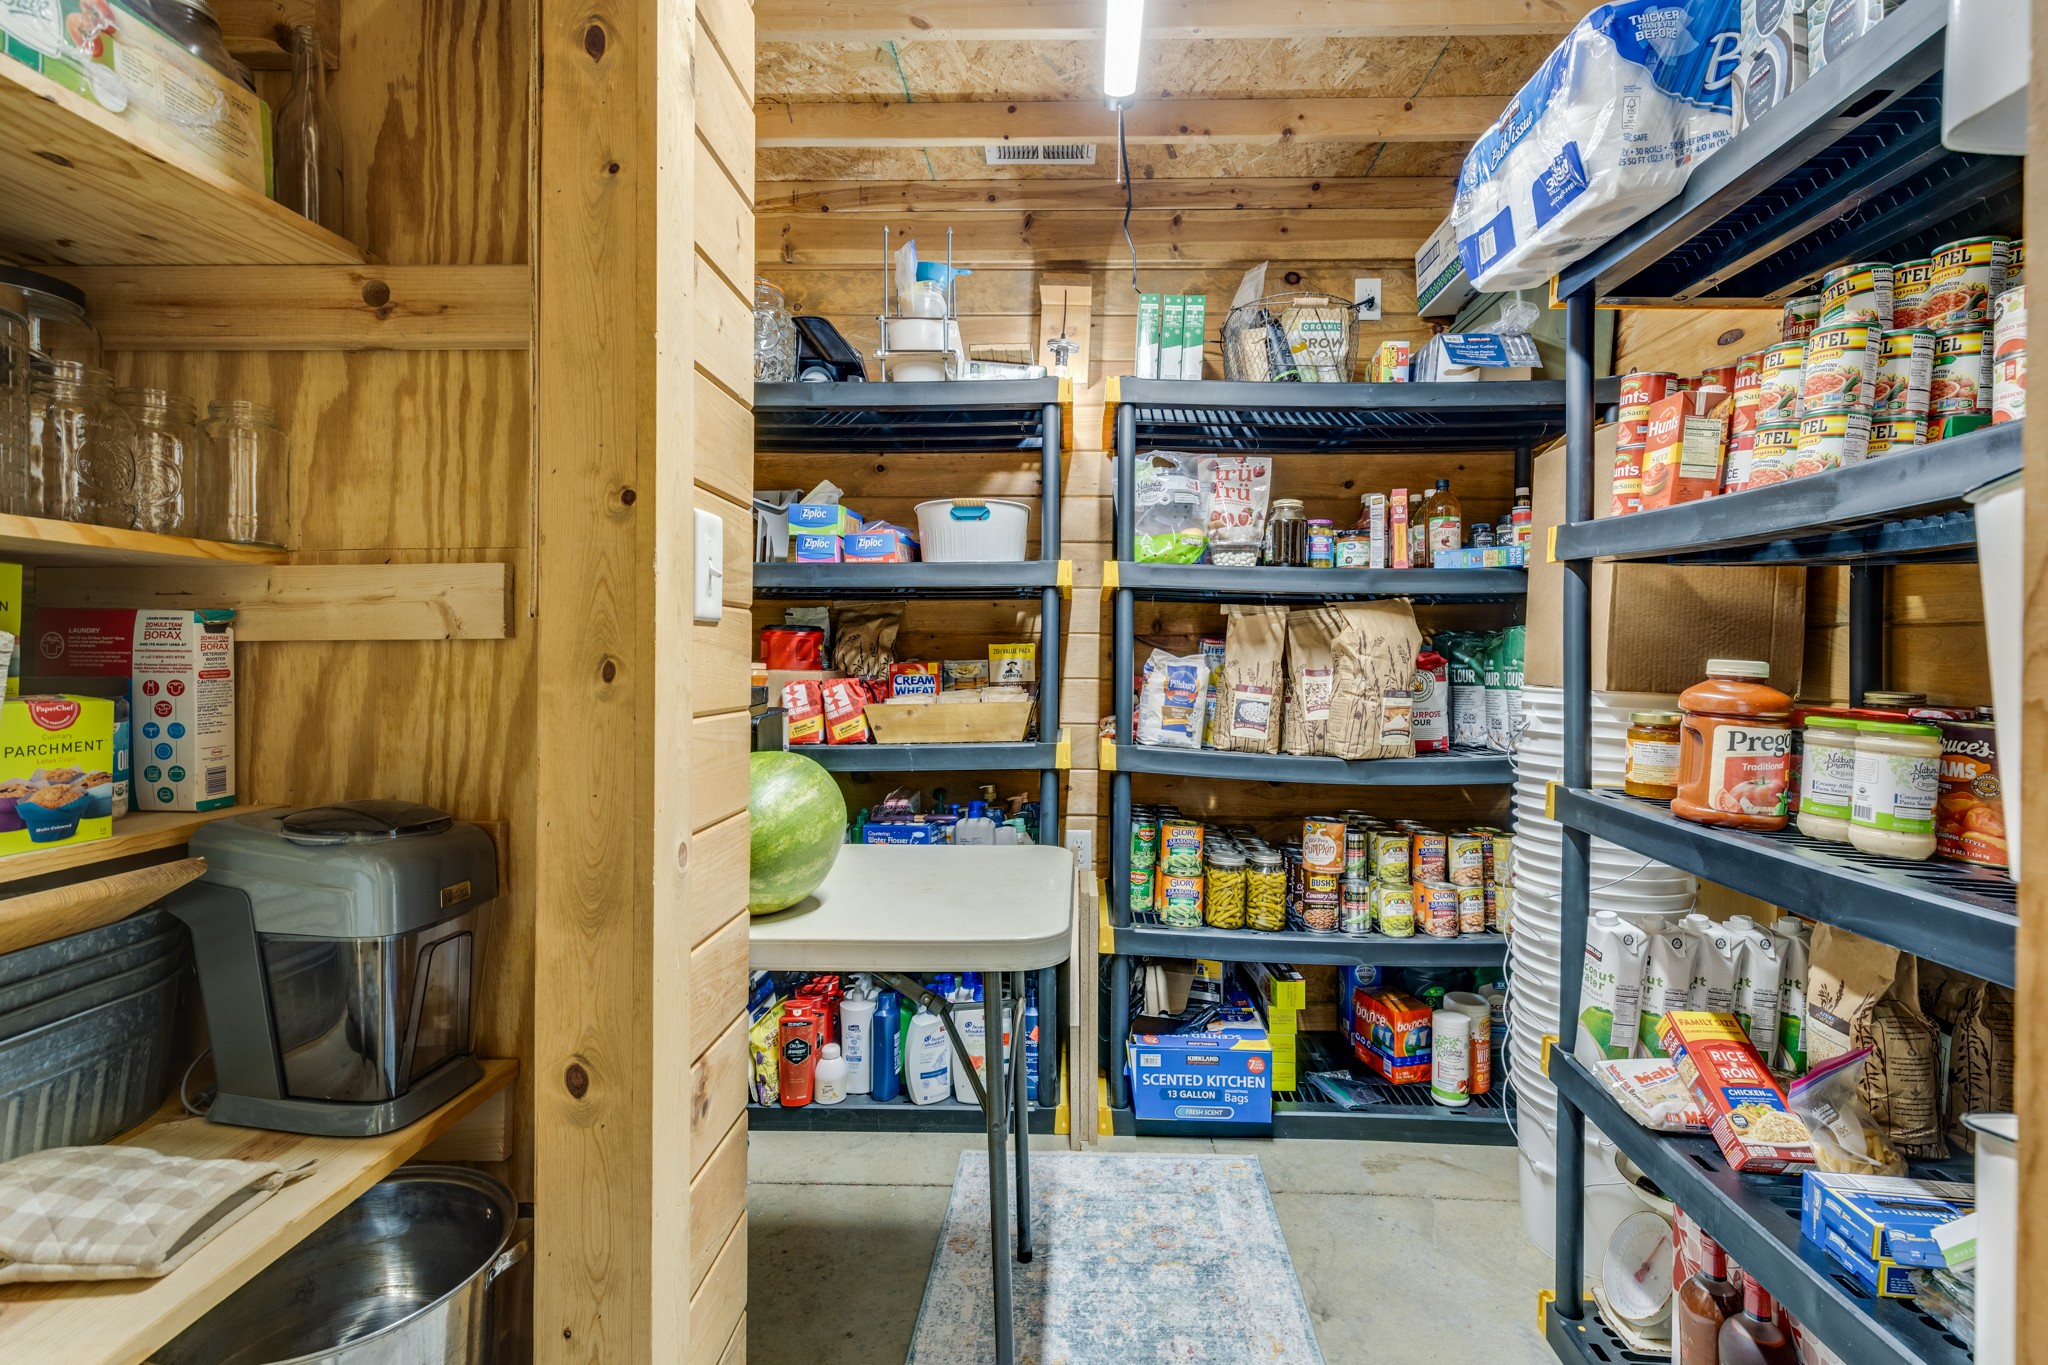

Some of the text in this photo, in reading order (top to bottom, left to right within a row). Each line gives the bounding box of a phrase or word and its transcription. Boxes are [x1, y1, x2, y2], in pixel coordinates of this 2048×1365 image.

[1628, 9, 1680, 26] THICKER
[1636, 20, 1676, 31] THAN EVER
[1635, 27, 1678, 42] BEFORE
[1633, 133, 1649, 142] SAFE
[1696, 133, 1711, 143] PER
[1712, 129, 1731, 139] ROLL
[1490, 135, 1511, 170] Bath
[1303, 323, 1342, 331] ORGANIC
[1785, 324, 1813, 336] adina
[1619, 389, 1649, 404] unt's
[1627, 409, 1650, 417] Sauce
[1648, 415, 1679, 438] Hunt's
[1215, 464, 1253, 482] trü
[1614, 465, 1641, 477] unt's
[1215, 480, 1252, 502] frü
[801, 508, 828, 520] Ziploc
[1432, 528, 1460, 539] APPLE CIDER
[804, 537, 831, 550] Ziploc
[858, 537, 883, 548] Ziploc
[144, 630, 182, 641] BORAX
[200, 643, 229, 651] BORAX
[1002, 647, 1017, 655] VALUE
[1018, 646, 1032, 654] PACK
[894, 674, 935, 686] CREAM
[1169, 679, 1197, 691] Pillsbury
[895, 686, 935, 696] WHEAT
[36, 703, 74, 714] PaperChef
[42, 732, 73, 740] Culinary
[4, 739, 104, 759] PARCHMENT
[1728, 730, 1791, 758] Prego
[36, 756, 76, 765] Lotus Cups
[1742, 760, 1785, 771] Traditional
[1940, 759, 1977, 780] AMS
[1815, 780, 1838, 788] Creamy
[1900, 793, 1923, 801] Creamy
[35, 822, 72, 833] Multi-Coloured
[1171, 828, 1198, 838] GLORY
[867, 830, 891, 838] Countertop
[867, 836, 888, 844] Water
[1168, 838, 1200, 847] SEASONED
[1963, 837, 1988, 849] STYLE
[1304, 841, 1336, 857] Pumpkin
[1169, 878, 1196, 889] GLORY
[1311, 878, 1336, 888] BUSH'S
[1167, 888, 1199, 898] SEASONED
[1305, 892, 1328, 900] Country
[1584, 973, 1605, 991] ater
[1355, 1002, 1387, 1027] bounce
[1396, 1018, 1429, 1033] bounce
[1678, 1018, 1737, 1028] FAMILY SIZE
[924, 1040, 945, 1048] shoulders
[1663, 1030, 1676, 1048] RICE
[1477, 1050, 1490, 1064] WIP
[1711, 1050, 1748, 1063] RICE
[1248, 1059, 1255, 1070] 7
[1720, 1067, 1759, 1080] RONI
[1142, 1073, 1266, 1089] SCENTED KITCHEN
[1167, 1090, 1216, 1099] 13 GALLON
[1728, 1089, 1765, 1097] CHICKEN
[1224, 1093, 1249, 1105] Bags
